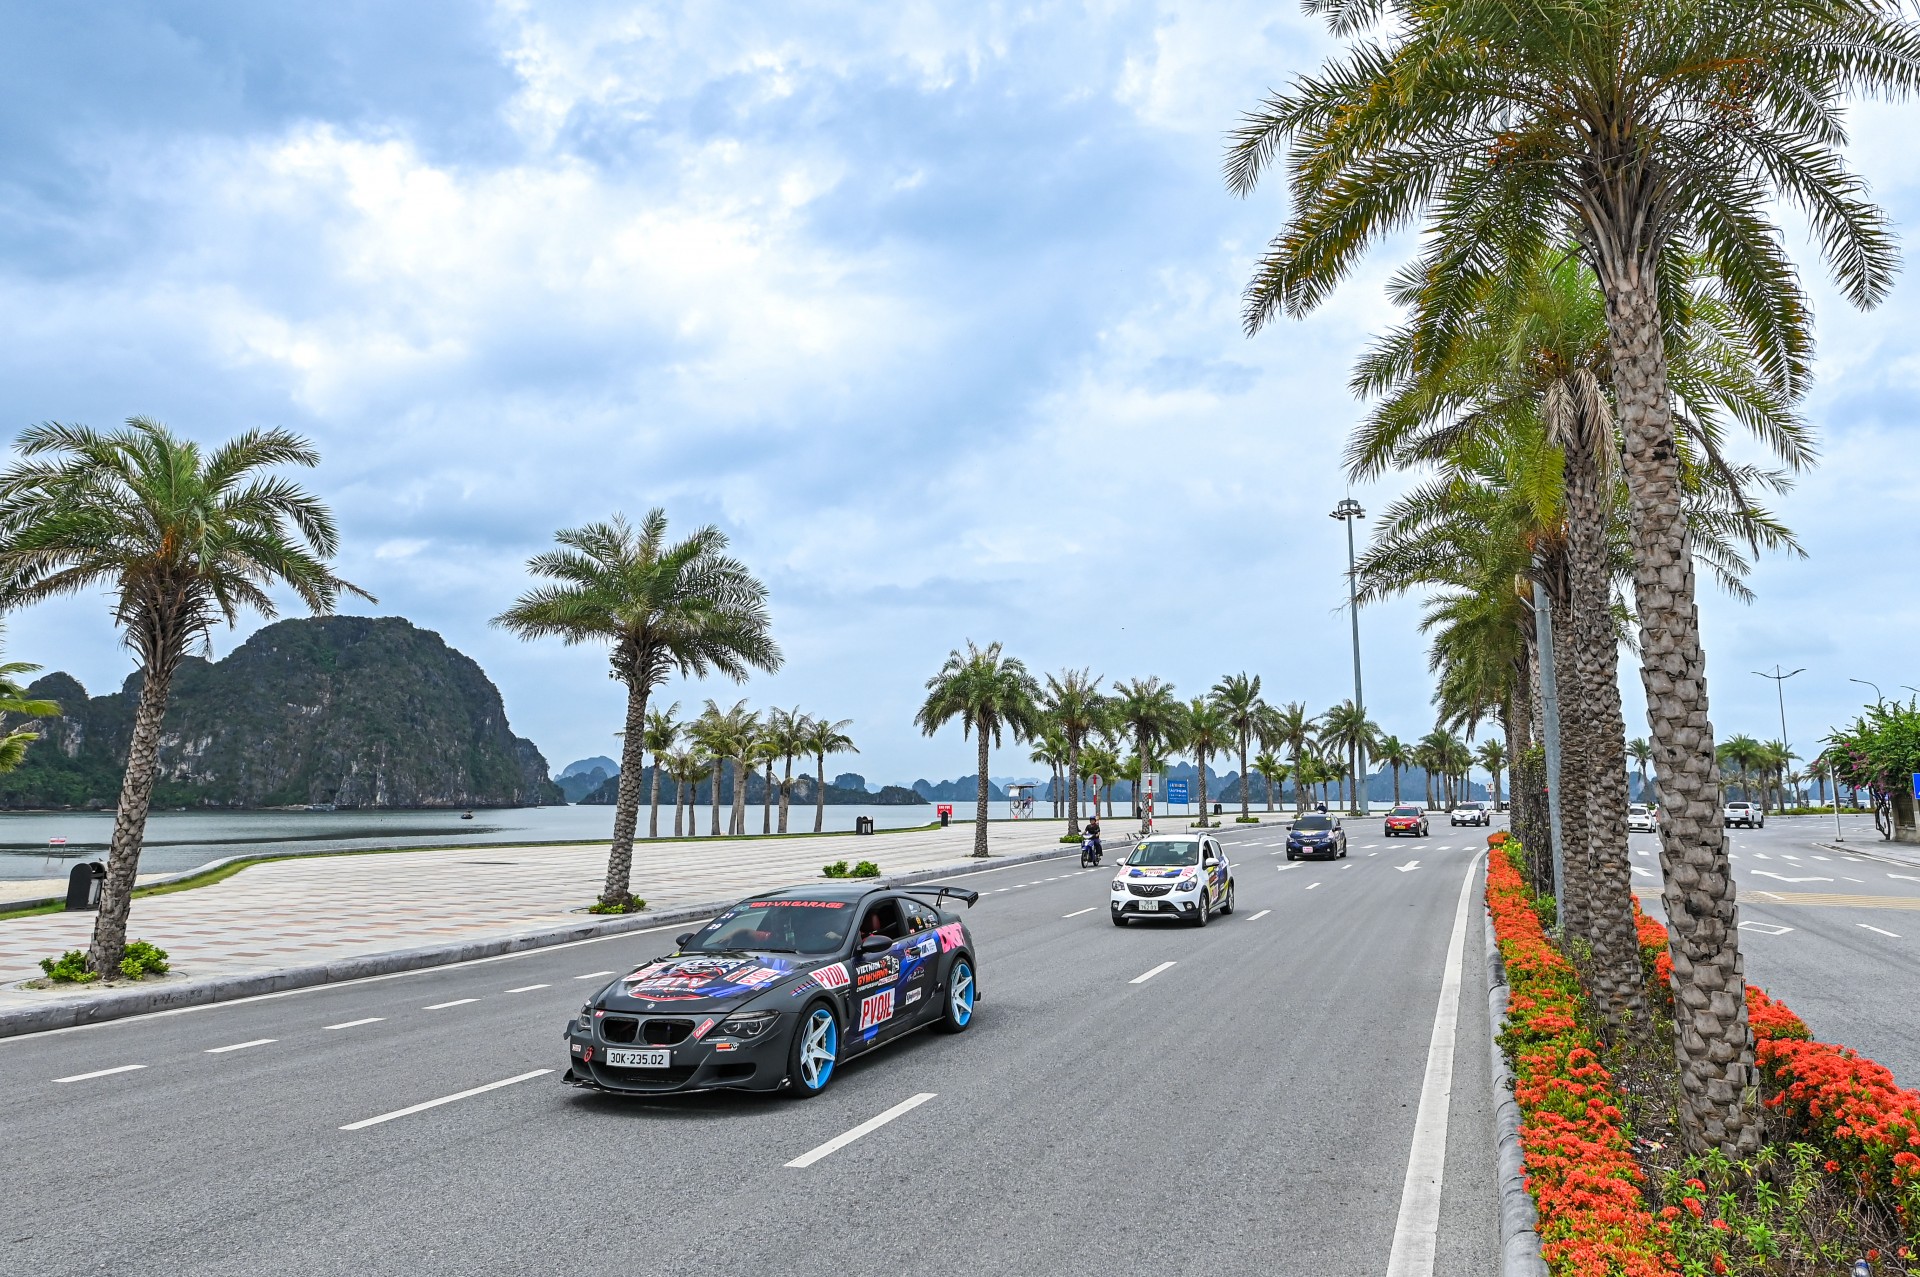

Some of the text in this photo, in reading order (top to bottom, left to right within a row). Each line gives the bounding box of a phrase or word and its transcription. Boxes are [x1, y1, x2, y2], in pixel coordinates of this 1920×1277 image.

[792, 901, 845, 909] GARAGE
[856, 960, 881, 975] VIETNAM
[812, 964, 849, 988] PVOIL
[857, 968, 889, 986] GYMKHANA
[861, 991, 892, 1029] PVOIL
[610, 1052, 664, 1065] 30K-235.02
